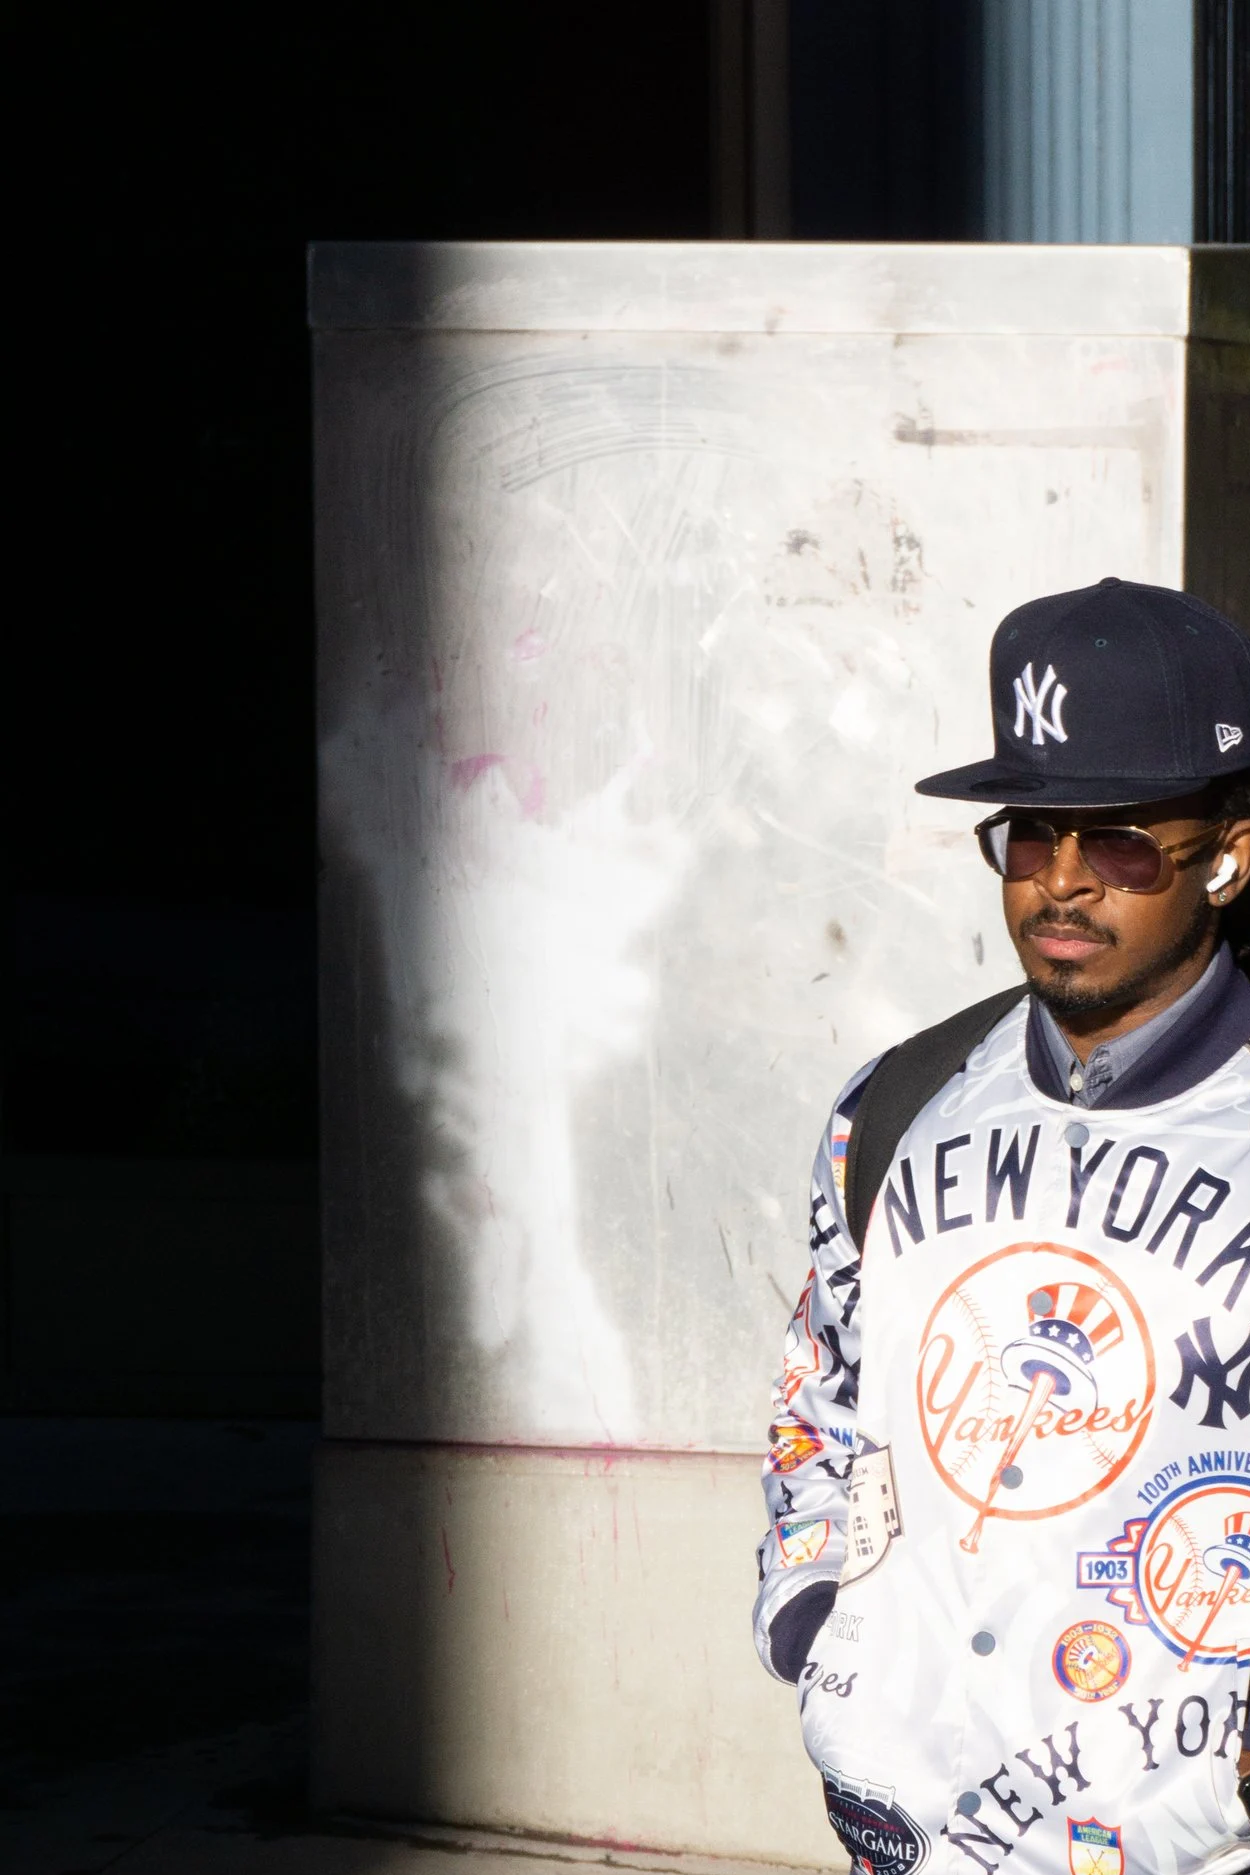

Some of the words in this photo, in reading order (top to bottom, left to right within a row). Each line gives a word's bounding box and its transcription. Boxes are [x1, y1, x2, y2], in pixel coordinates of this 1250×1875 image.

[1012, 662, 1069, 746] NY
[883, 1124, 1042, 1258] NEW
[920, 1333, 1138, 1457] Yankees
[1136, 1461, 1182, 1506] 100TH
[1085, 1560, 1129, 1581] 1903
